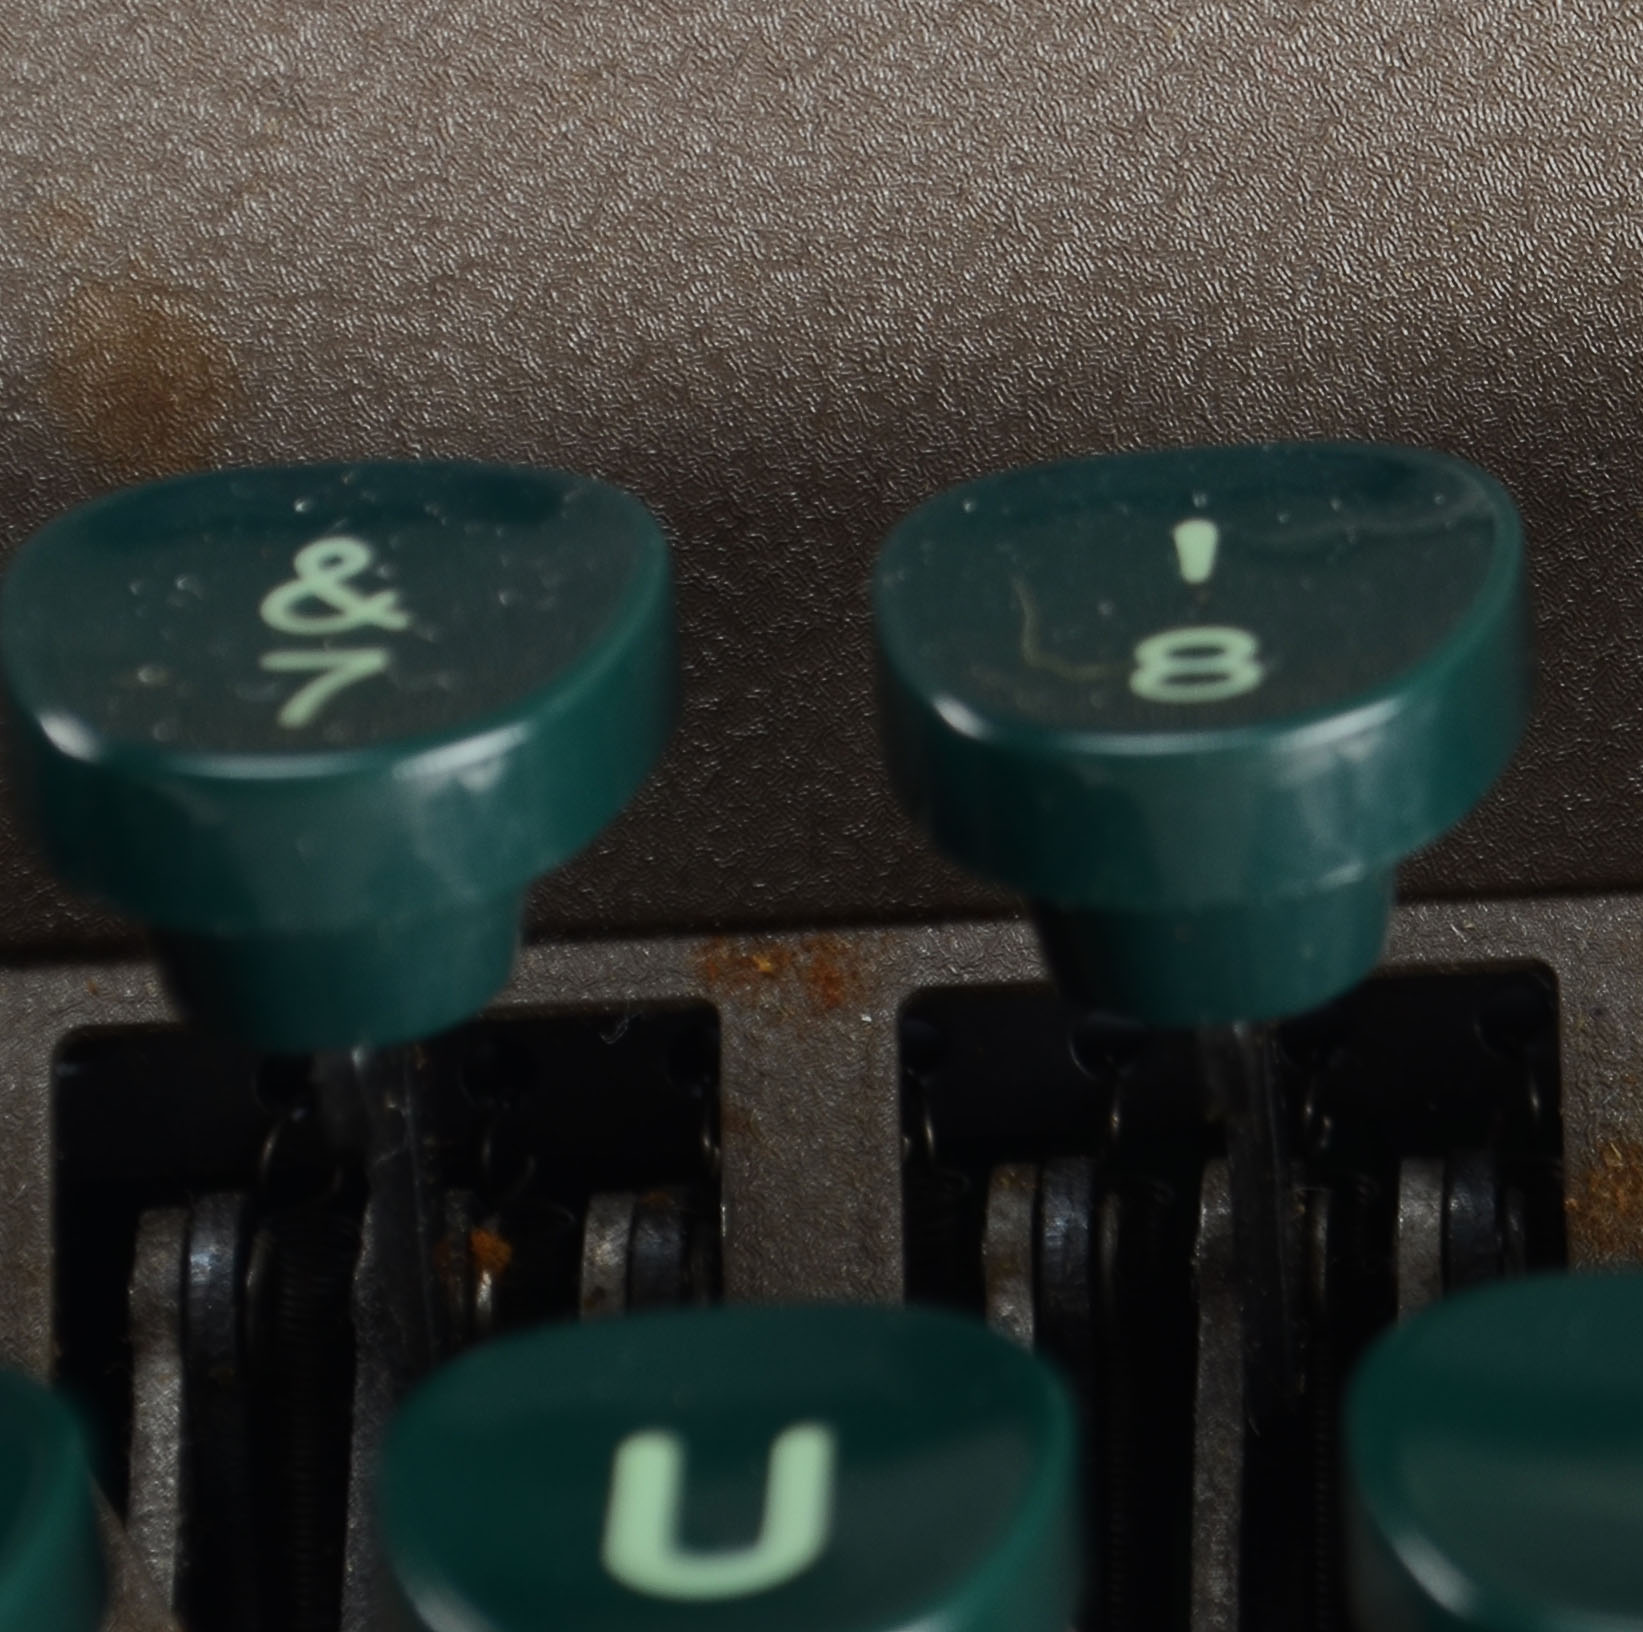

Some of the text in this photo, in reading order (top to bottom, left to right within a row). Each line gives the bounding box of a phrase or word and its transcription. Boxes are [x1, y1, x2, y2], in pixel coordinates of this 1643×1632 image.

[260, 535, 410, 635] &
[260, 647, 390, 727] 7
[1128, 626, 1264, 702] 8
[604, 1424, 833, 1599] U
